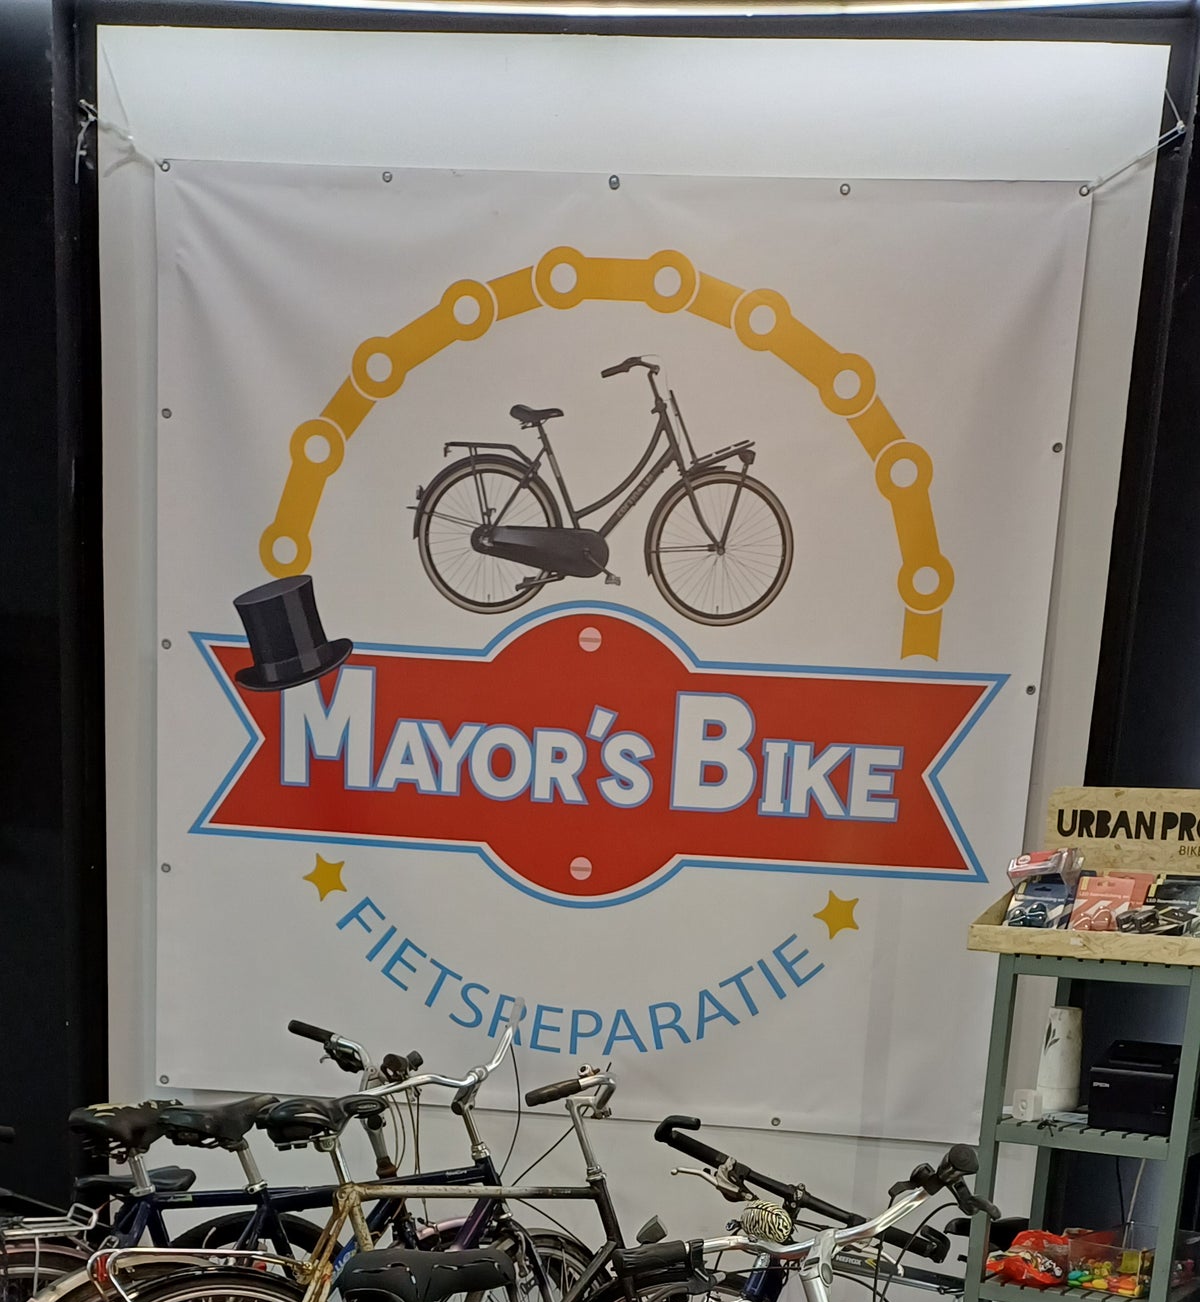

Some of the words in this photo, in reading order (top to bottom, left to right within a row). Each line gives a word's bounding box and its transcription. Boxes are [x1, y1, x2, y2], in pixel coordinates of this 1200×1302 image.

[281, 665, 655, 808] MAYOR'S
[670, 691, 904, 822] BIKE
[1057, 809, 1156, 840] URBAN
[336, 896, 825, 1056] FIETSREPARATIE
